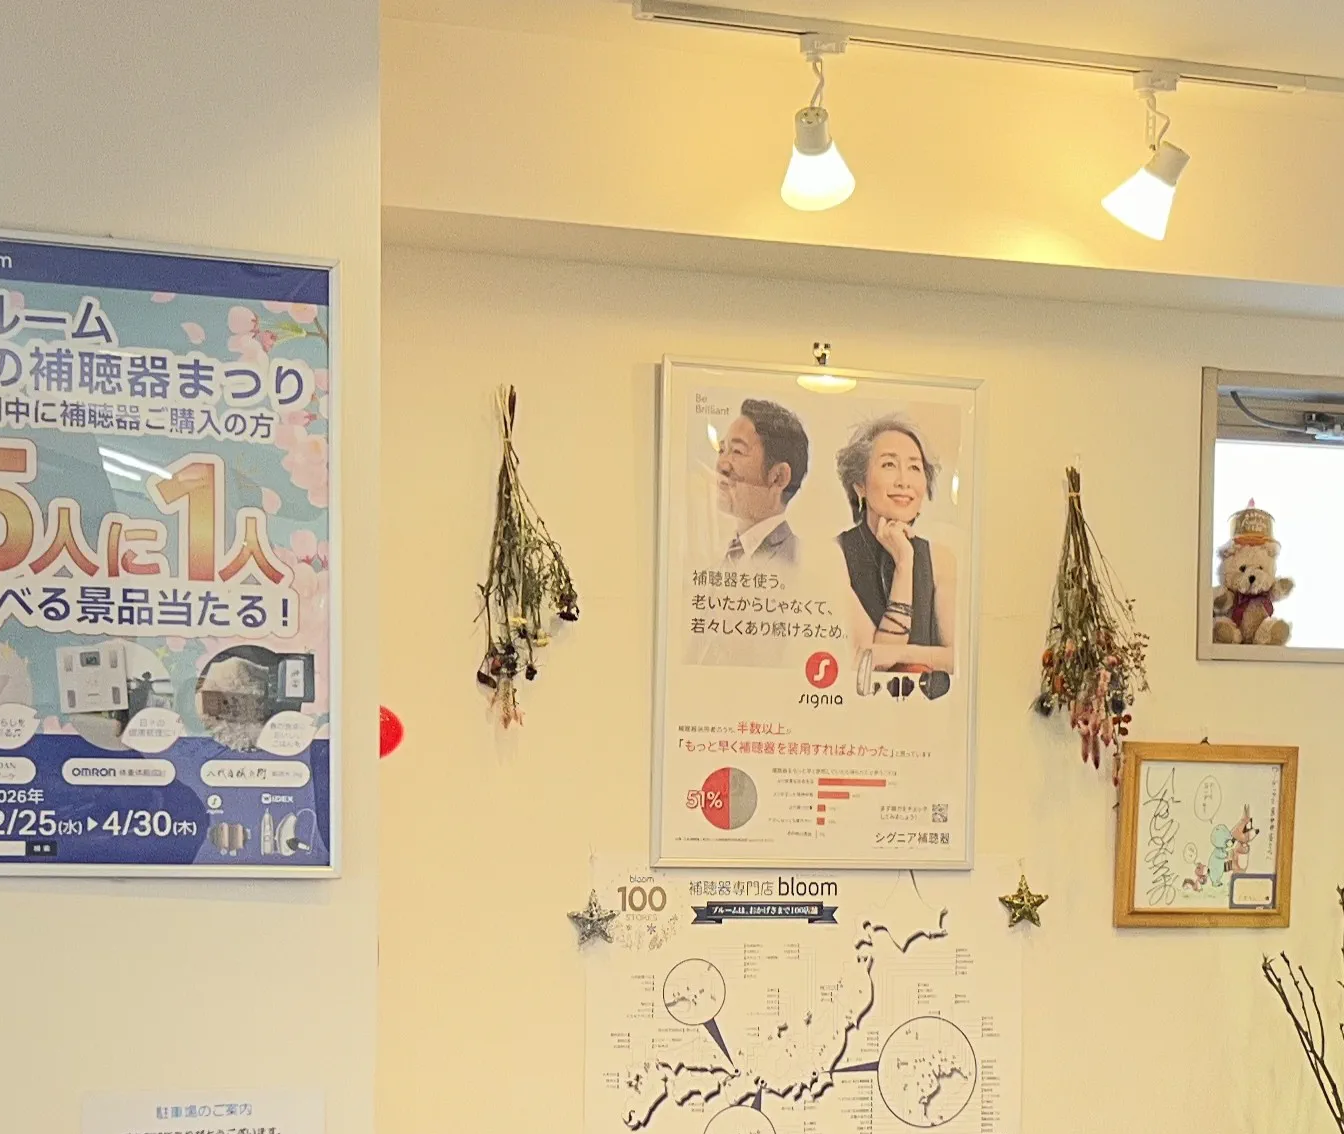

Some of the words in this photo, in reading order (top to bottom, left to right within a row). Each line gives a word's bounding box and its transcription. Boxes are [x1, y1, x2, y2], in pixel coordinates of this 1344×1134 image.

[692, 569, 786, 590] 補聴器を使う。
[691, 593, 834, 617] 老いたからじゃなくて、
[690, 617, 849, 640] 若々しくあり続けるため。
[798, 693, 844, 709] signia
[71, 766, 117, 778] OMRON
[686, 789, 724, 810] 51%
[874, 831, 951, 846] シグニア補聴器
[689, 880, 774, 896] 補聴器専門店
[777, 876, 838, 897] bloom
[617, 886, 667, 912] 100
